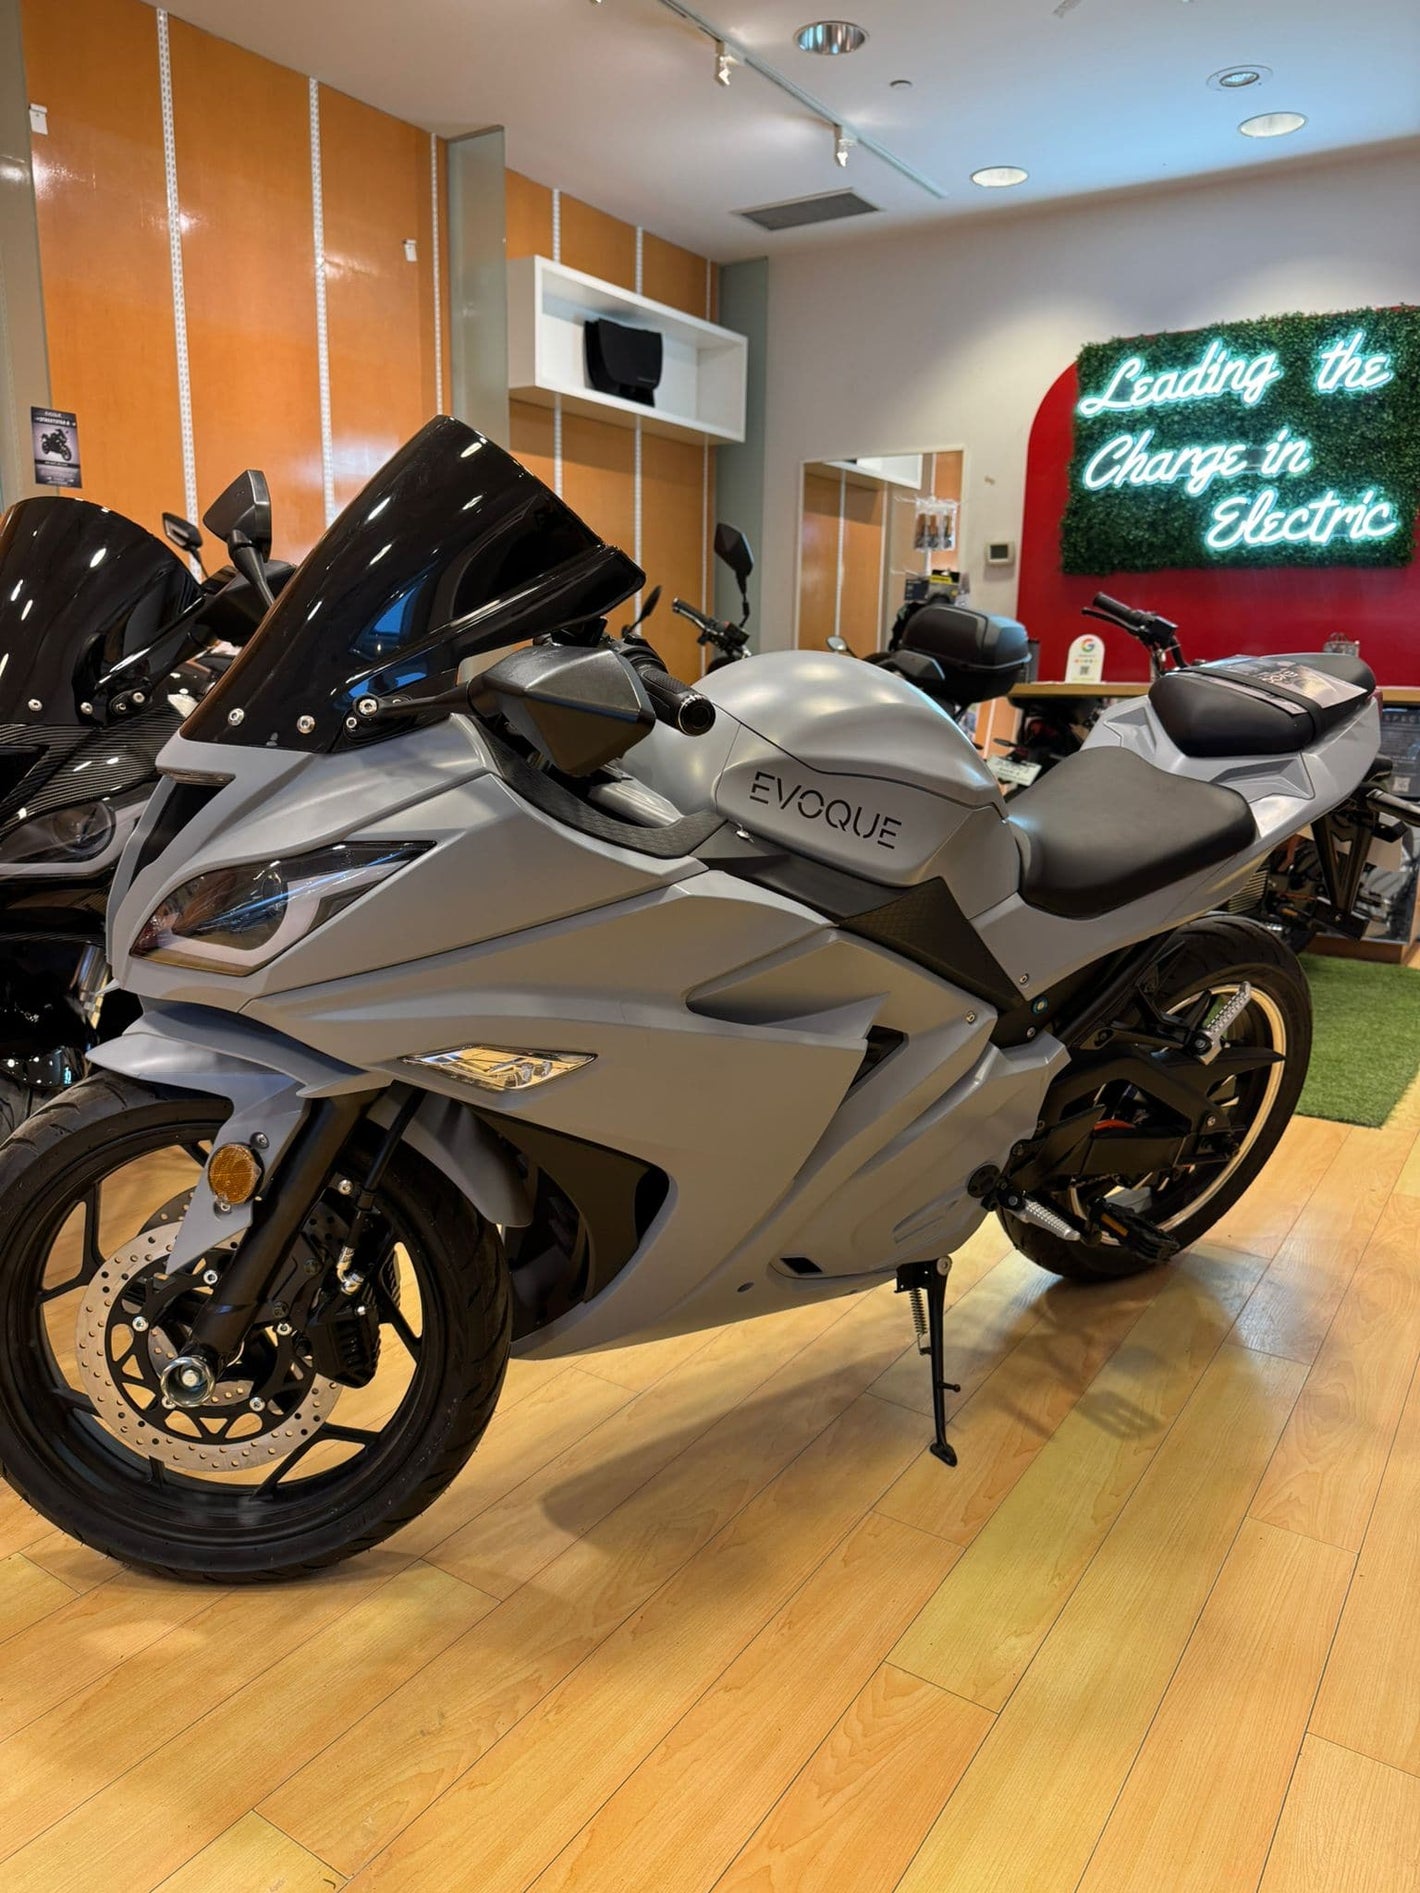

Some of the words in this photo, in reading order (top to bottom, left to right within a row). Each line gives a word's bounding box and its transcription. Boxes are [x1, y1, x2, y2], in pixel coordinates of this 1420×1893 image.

[1079, 339, 1282, 417] Leading
[1316, 331, 1394, 392] the
[1084, 429, 1249, 497] Charge
[1259, 428, 1312, 477] in
[1204, 489, 1399, 549] Electric
[750, 771, 902, 849] EVOQUE
